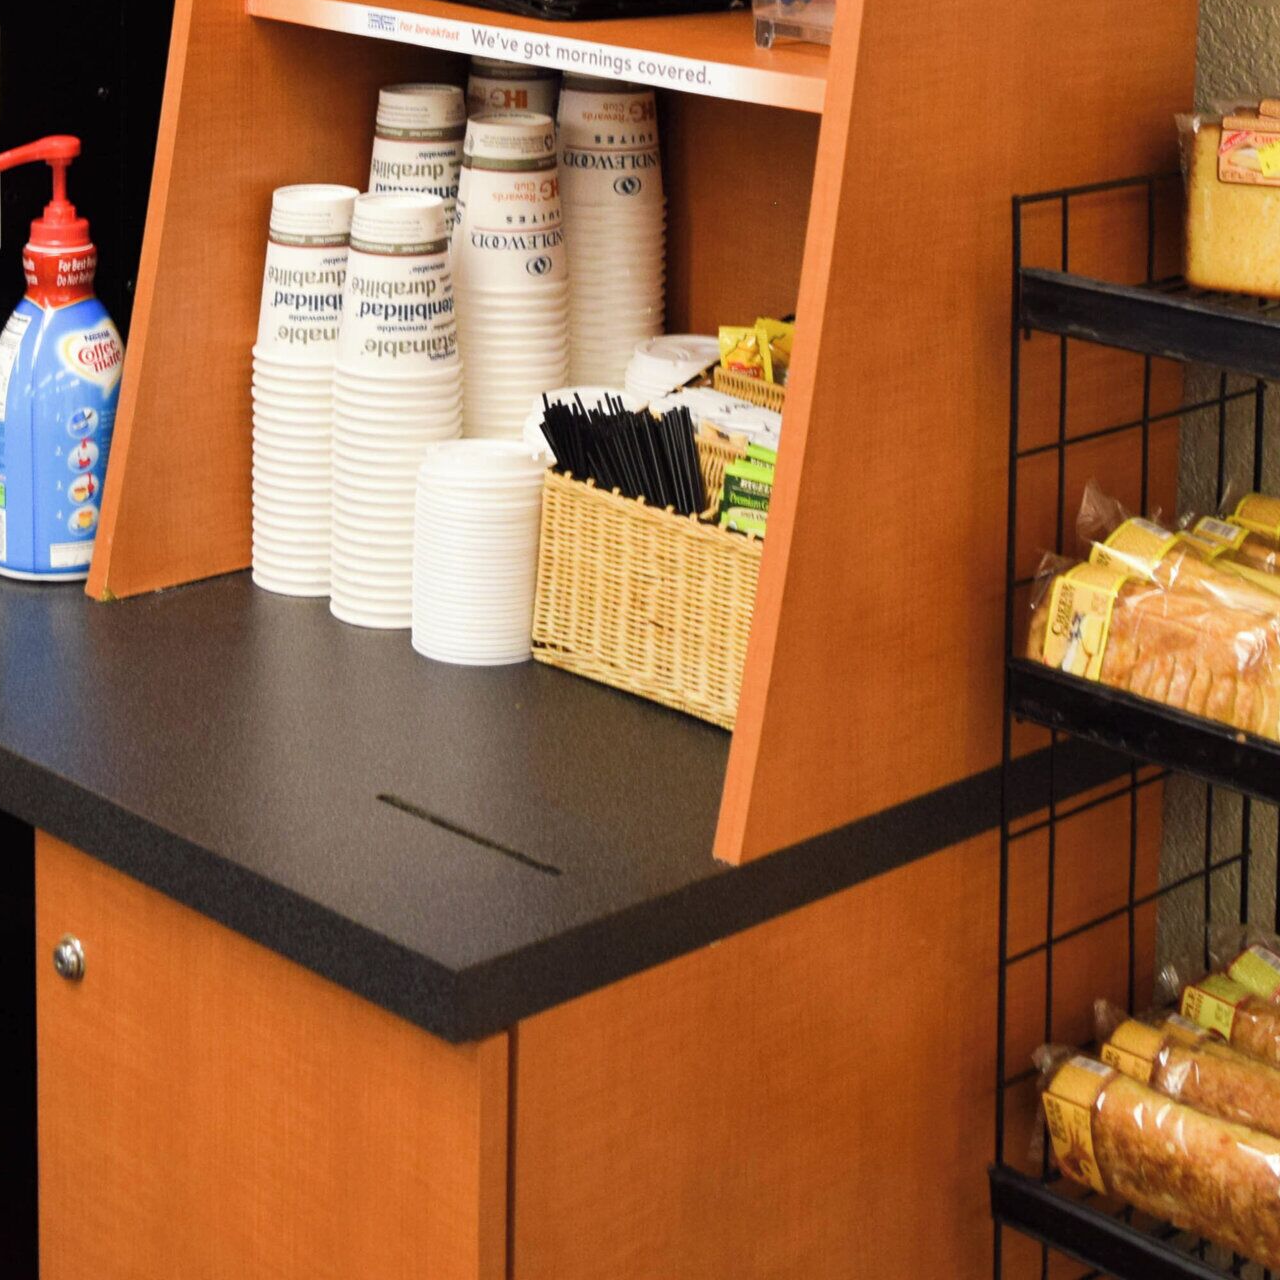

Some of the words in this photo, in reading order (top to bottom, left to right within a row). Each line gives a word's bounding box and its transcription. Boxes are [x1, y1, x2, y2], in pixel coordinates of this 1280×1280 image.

[399, 21, 413, 31] for
[415, 23, 460, 41] breakfast
[472, 28, 518, 51] We've
[524, 40, 550, 58] got
[556, 46, 632, 74] mornings
[638, 60, 712, 85] covered.
[59, 259, 71, 272] For
[72, 258, 86, 271] Best
[57, 274, 66, 287] Do
[78, 339, 117, 365] Coffee
